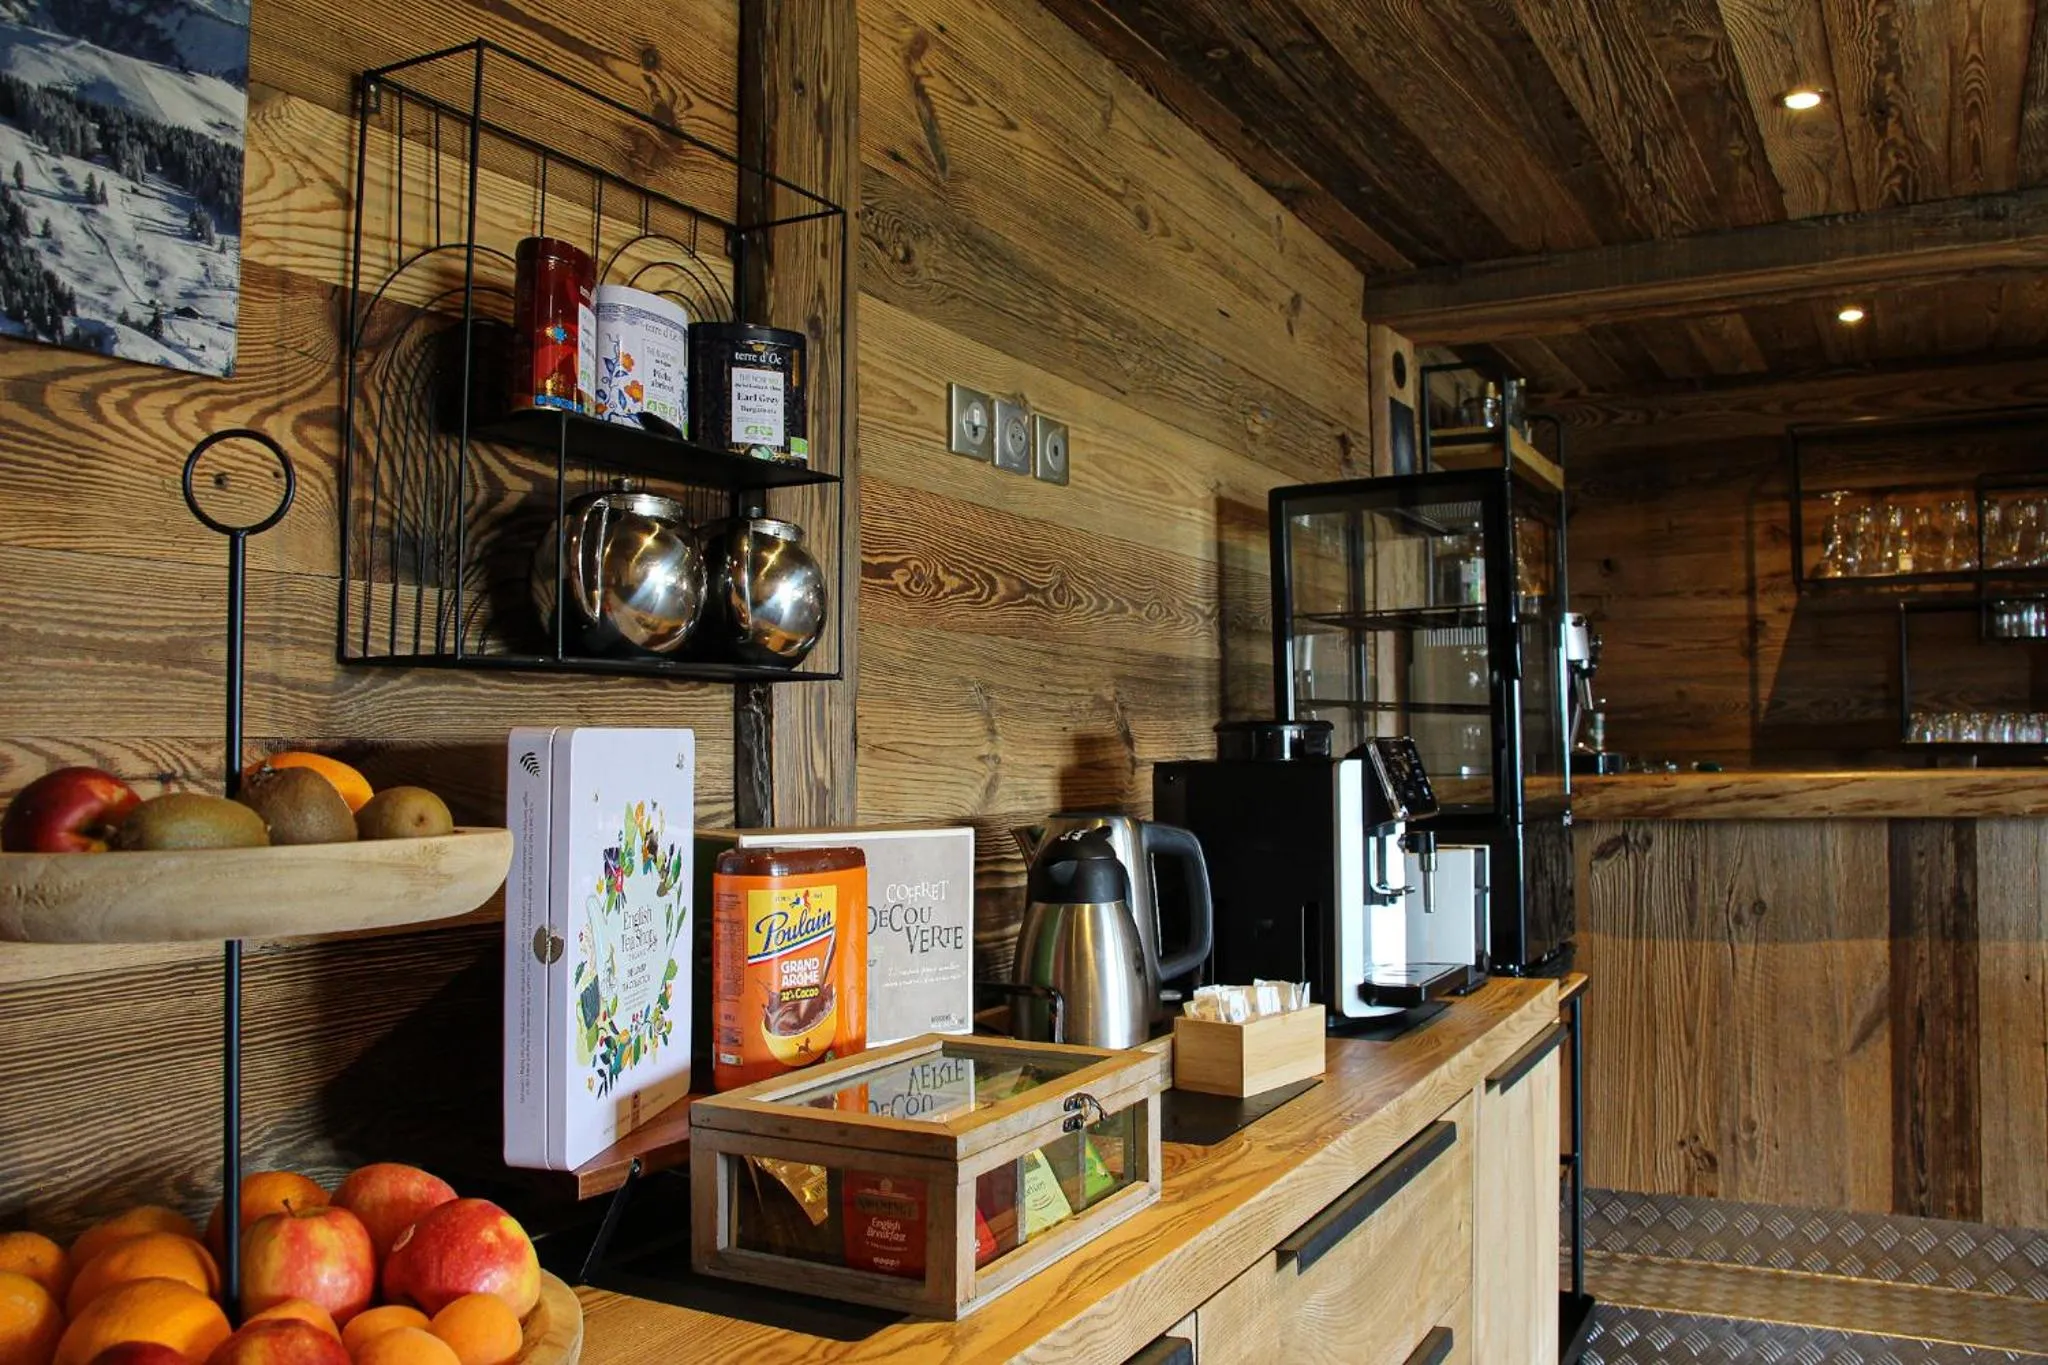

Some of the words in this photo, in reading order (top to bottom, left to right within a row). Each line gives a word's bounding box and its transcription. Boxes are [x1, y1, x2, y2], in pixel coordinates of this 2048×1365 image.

[735, 351, 757, 361] terre
[760, 351, 782, 365] d'Oc
[737, 392, 757, 401] Earl
[758, 394, 779, 405] Grey
[886, 880, 949, 904] COFFRET
[623, 905, 652, 931] English
[755, 908, 831, 952] Poulain
[906, 925, 964, 954] VERTE
[781, 957, 819, 974] GRAND
[781, 970, 819, 986] ARÔME
[871, 1217, 901, 1231] English
[866, 1226, 907, 1242] Breakfast
